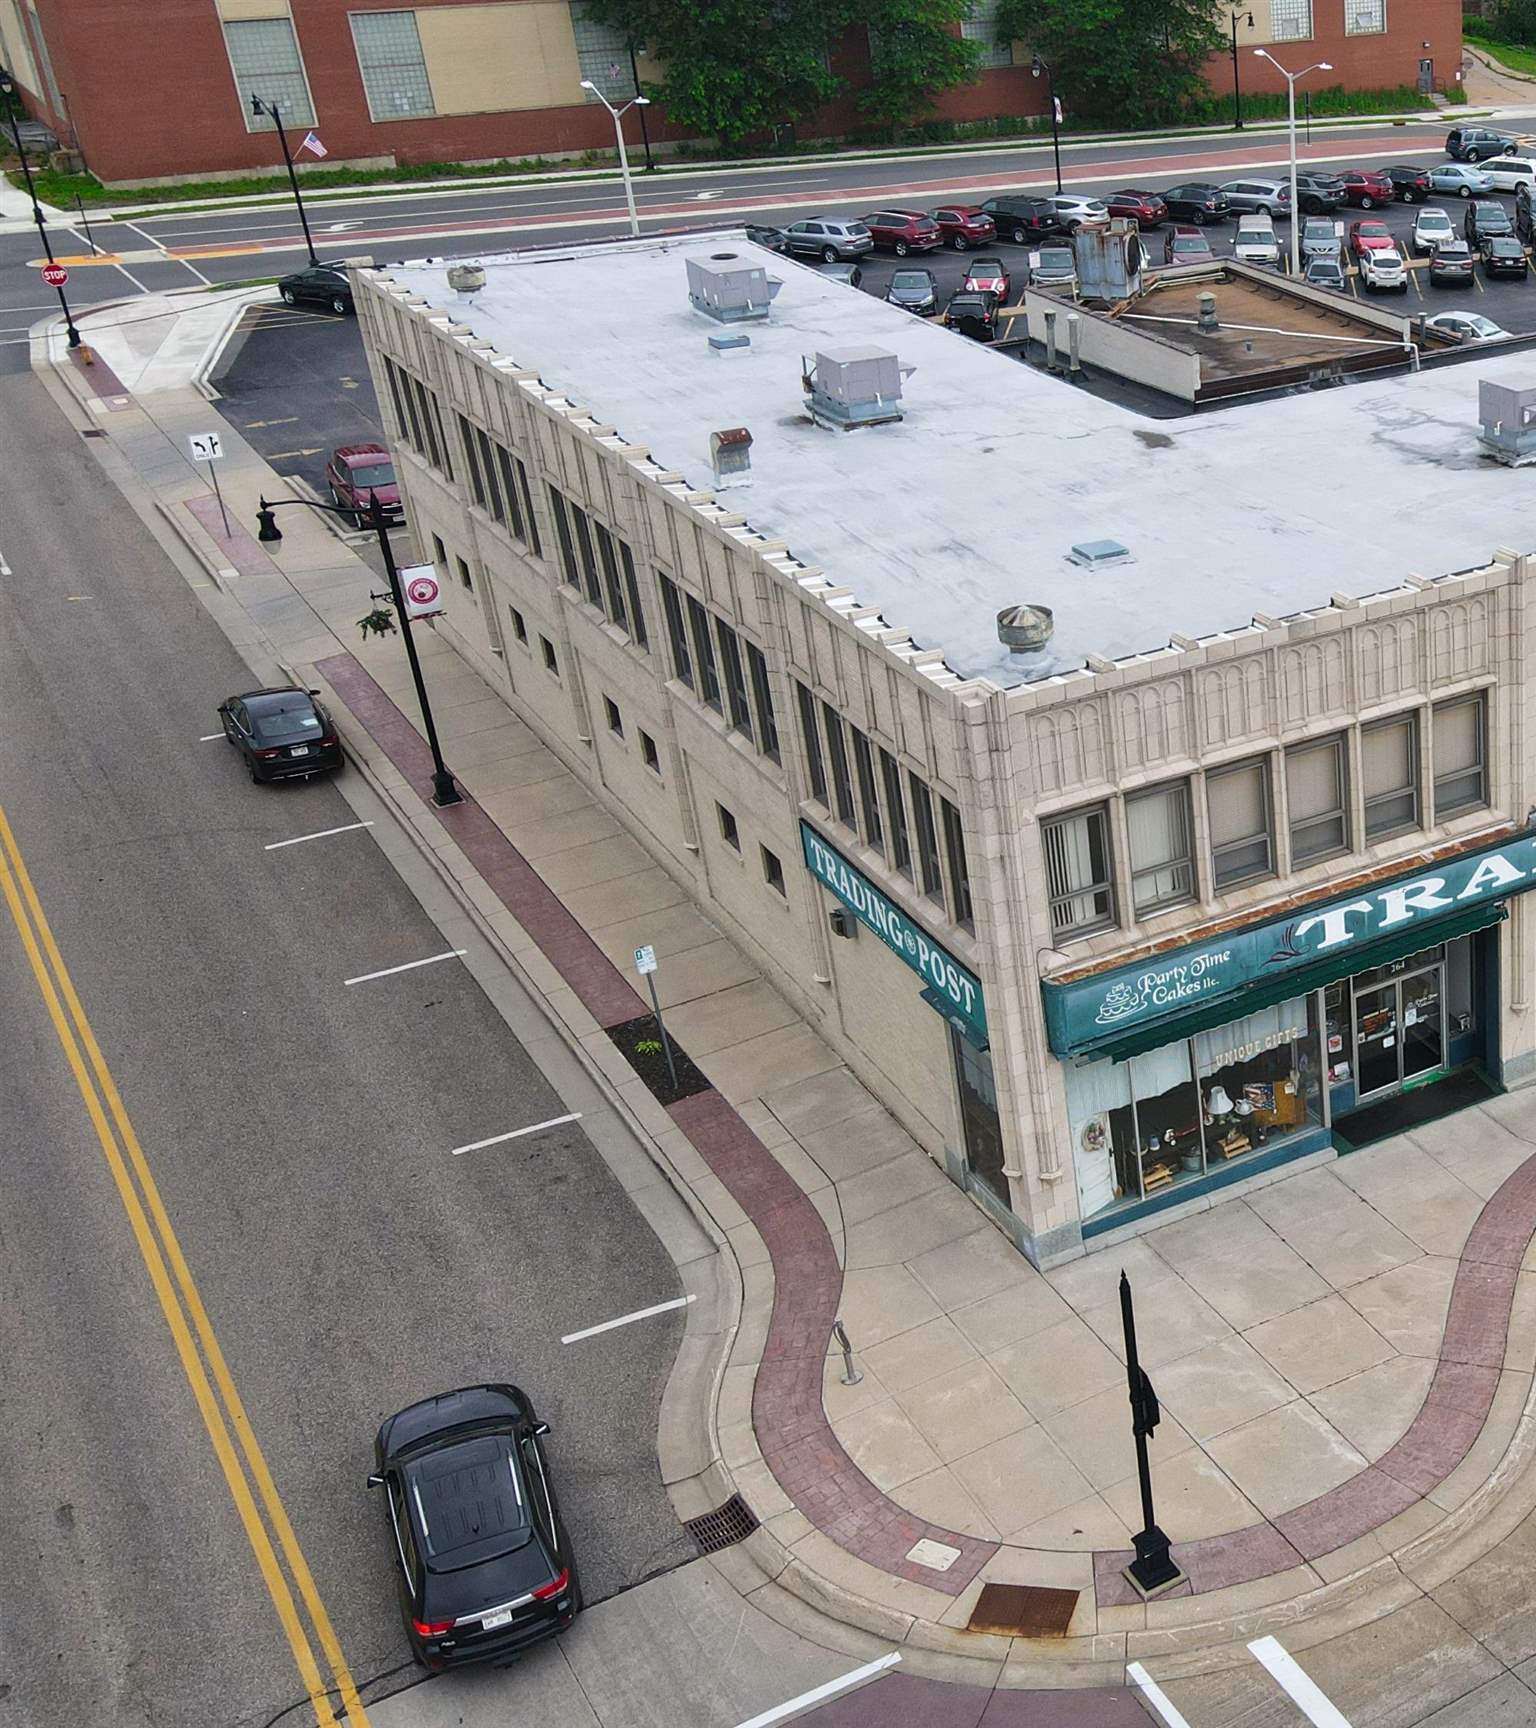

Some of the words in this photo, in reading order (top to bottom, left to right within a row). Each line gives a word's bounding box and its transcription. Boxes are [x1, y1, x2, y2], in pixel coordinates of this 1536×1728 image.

[44, 270, 66, 280] STOP
[810, 837, 904, 950] TRADING
[915, 934, 977, 1014] POST
[1137, 965, 1188, 995] Party
[1189, 950, 1232, 977] Time
[1152, 979, 1201, 1005] Cakes
[1215, 1040, 1261, 1068] UNIQUE
[1264, 1028, 1299, 1049] GIFTS
